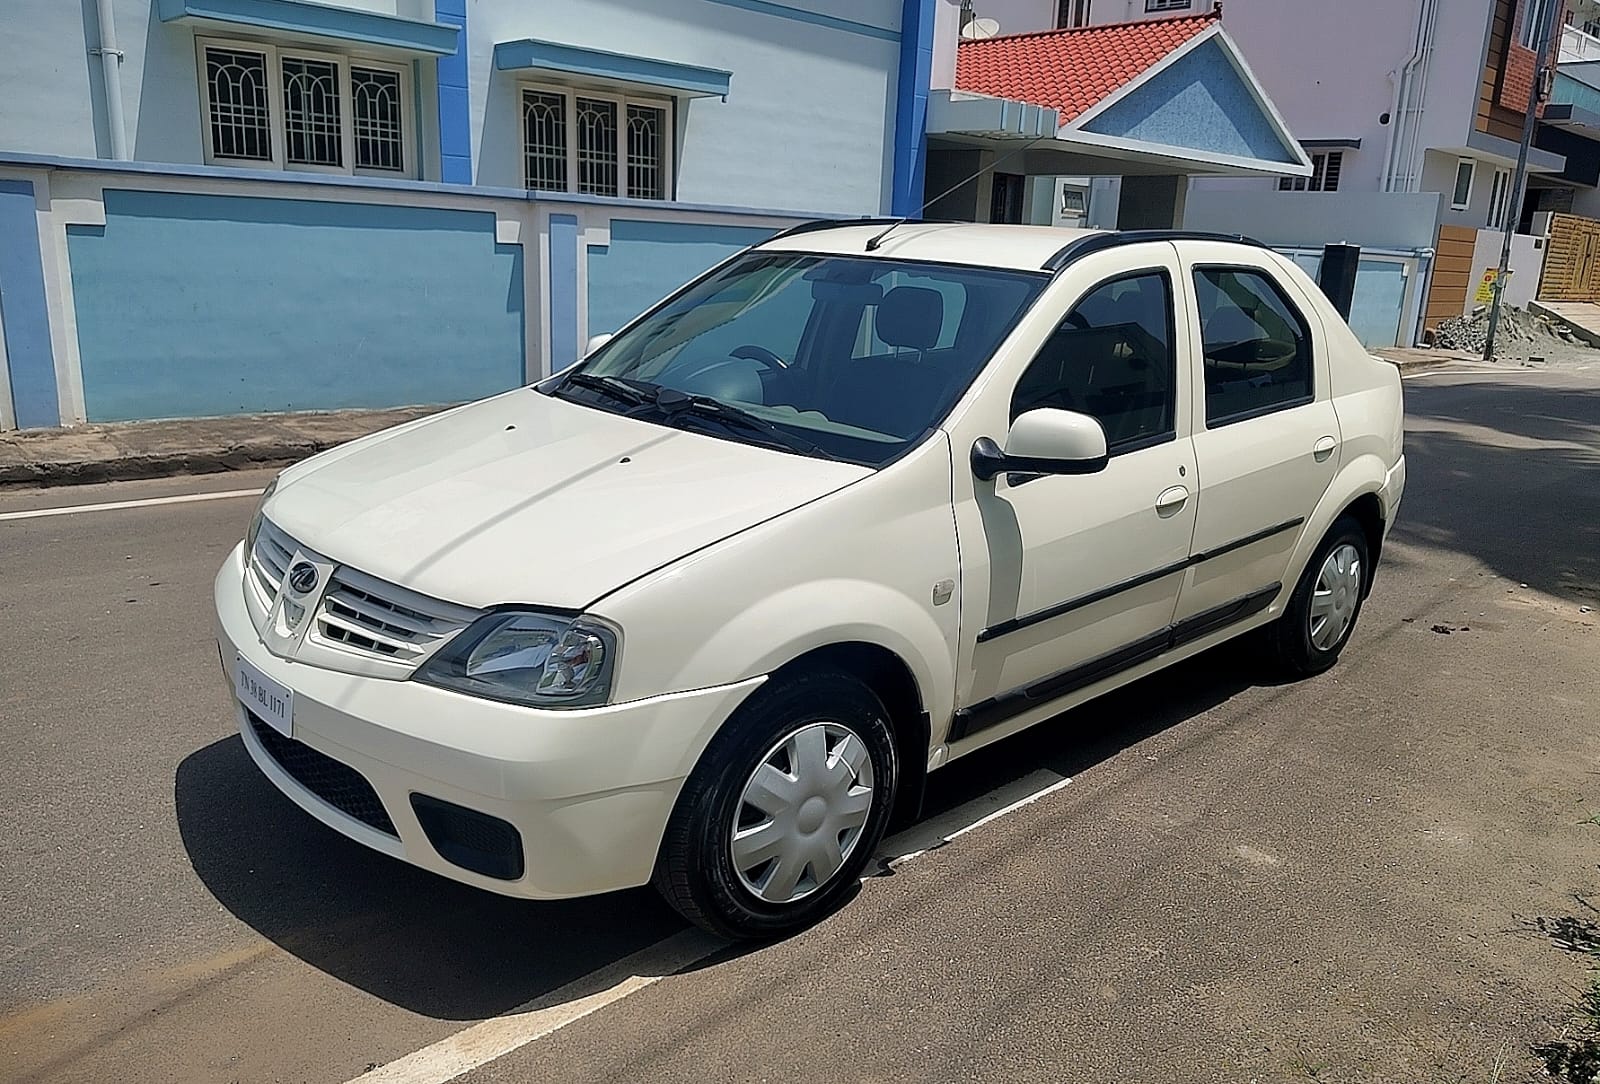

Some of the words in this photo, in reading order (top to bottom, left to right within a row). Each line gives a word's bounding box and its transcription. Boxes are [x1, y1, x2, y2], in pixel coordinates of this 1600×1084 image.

[240, 670, 250, 691] TN
[258, 686, 268, 707] BL
[270, 695, 284, 719] 1171
